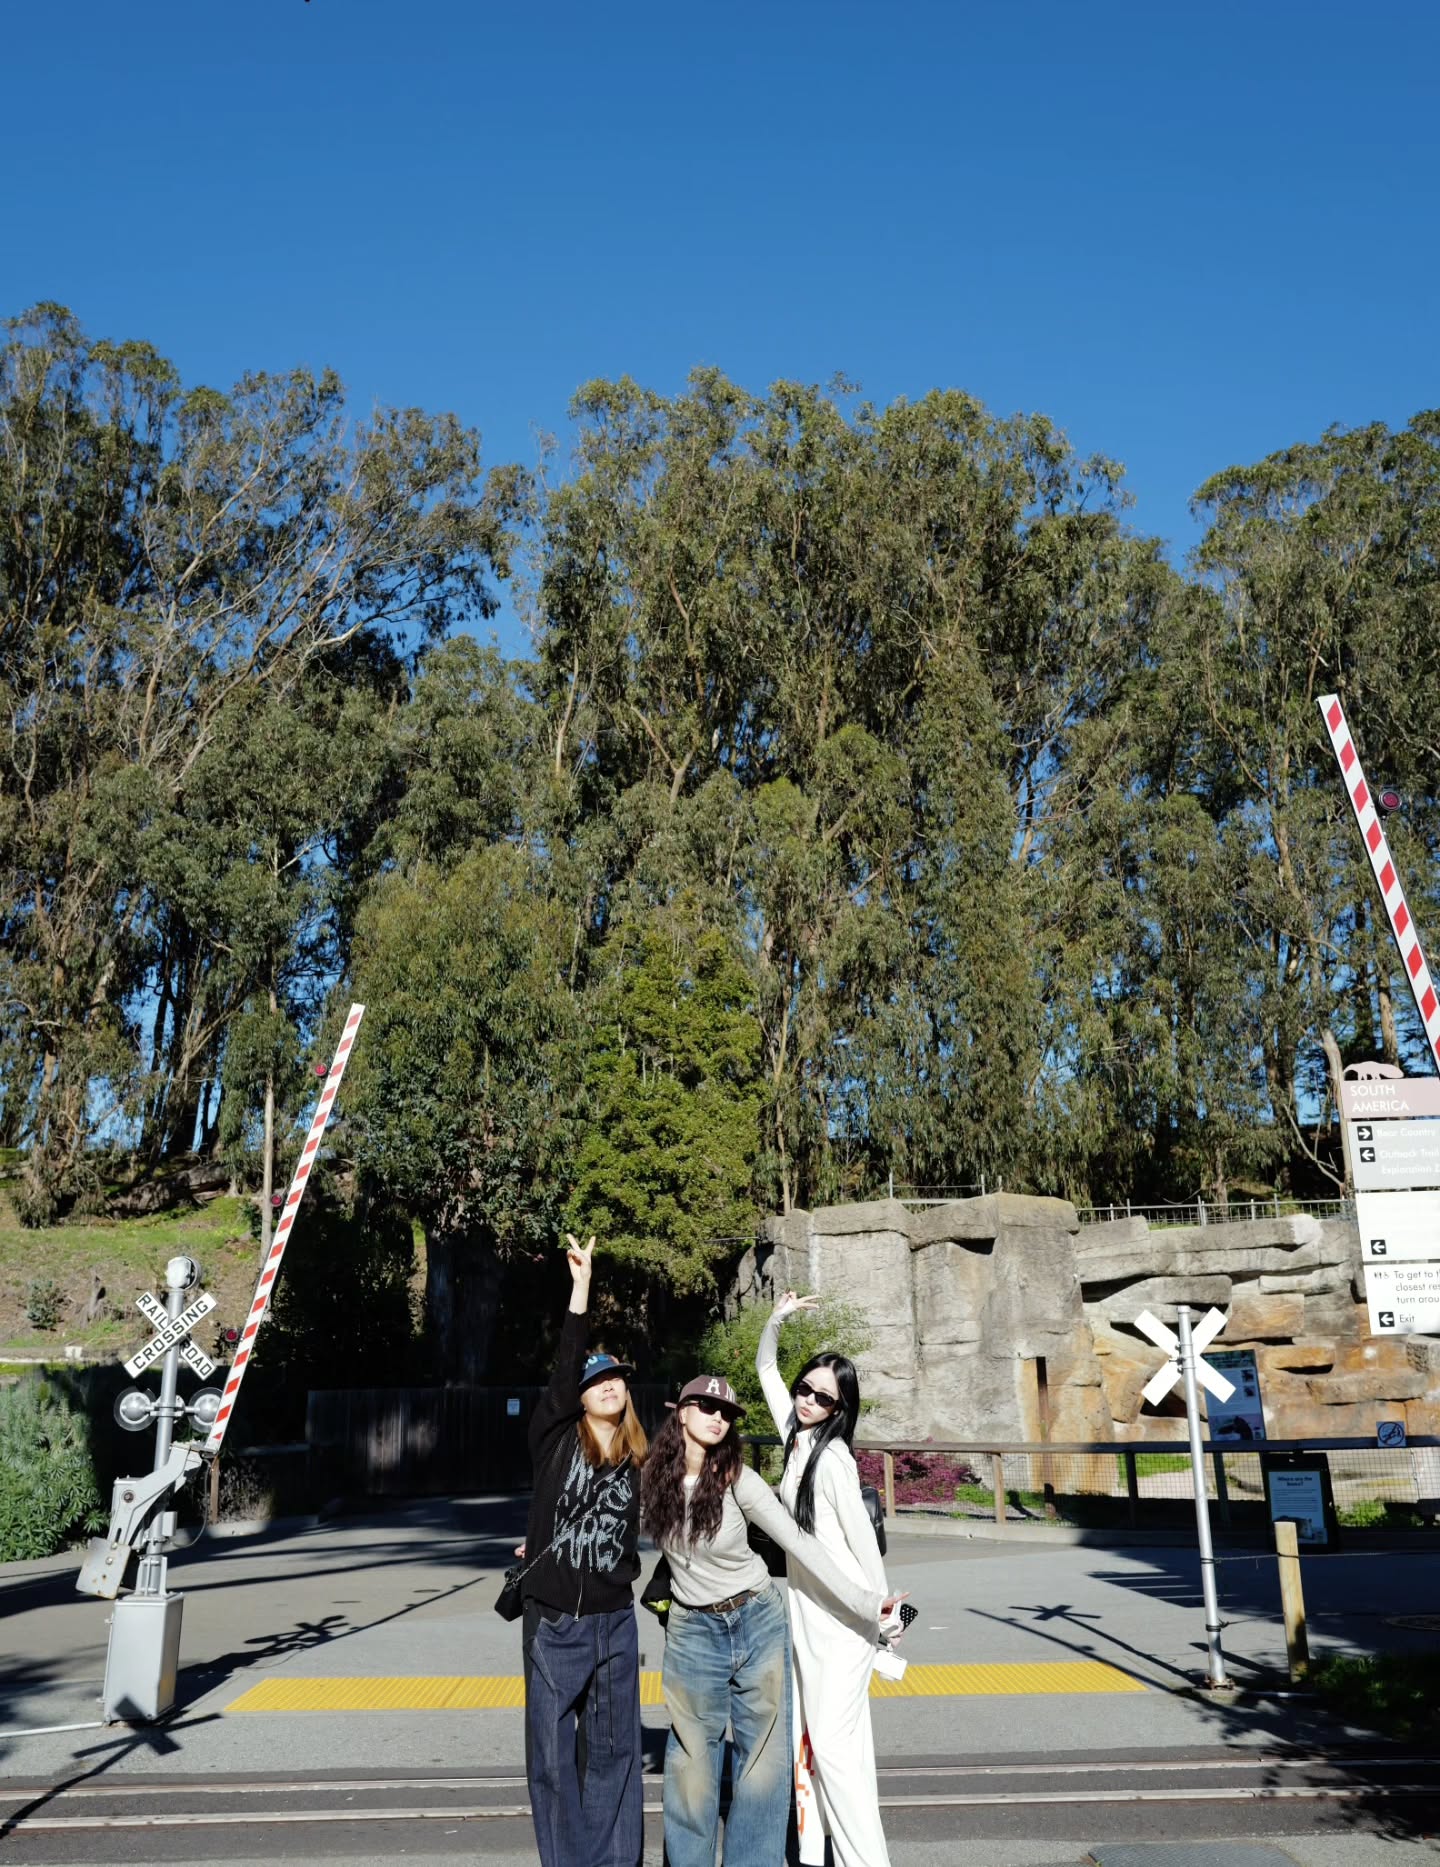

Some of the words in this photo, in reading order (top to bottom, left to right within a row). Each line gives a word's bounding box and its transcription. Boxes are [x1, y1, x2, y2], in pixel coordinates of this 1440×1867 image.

[1350, 1084, 1396, 1097] SOUTH
[1352, 1099, 1410, 1113] AMERICA
[1393, 1270, 1404, 1279] To
[1407, 1271, 1421, 1281] get
[1395, 1282, 1426, 1292] closest
[1397, 1296, 1416, 1305] turn
[1399, 1313, 1416, 1323] Exit
[133, 1301, 209, 1370] CROSSING
[138, 1293, 169, 1330] RAIL
[179, 1338, 213, 1376] ROAD
